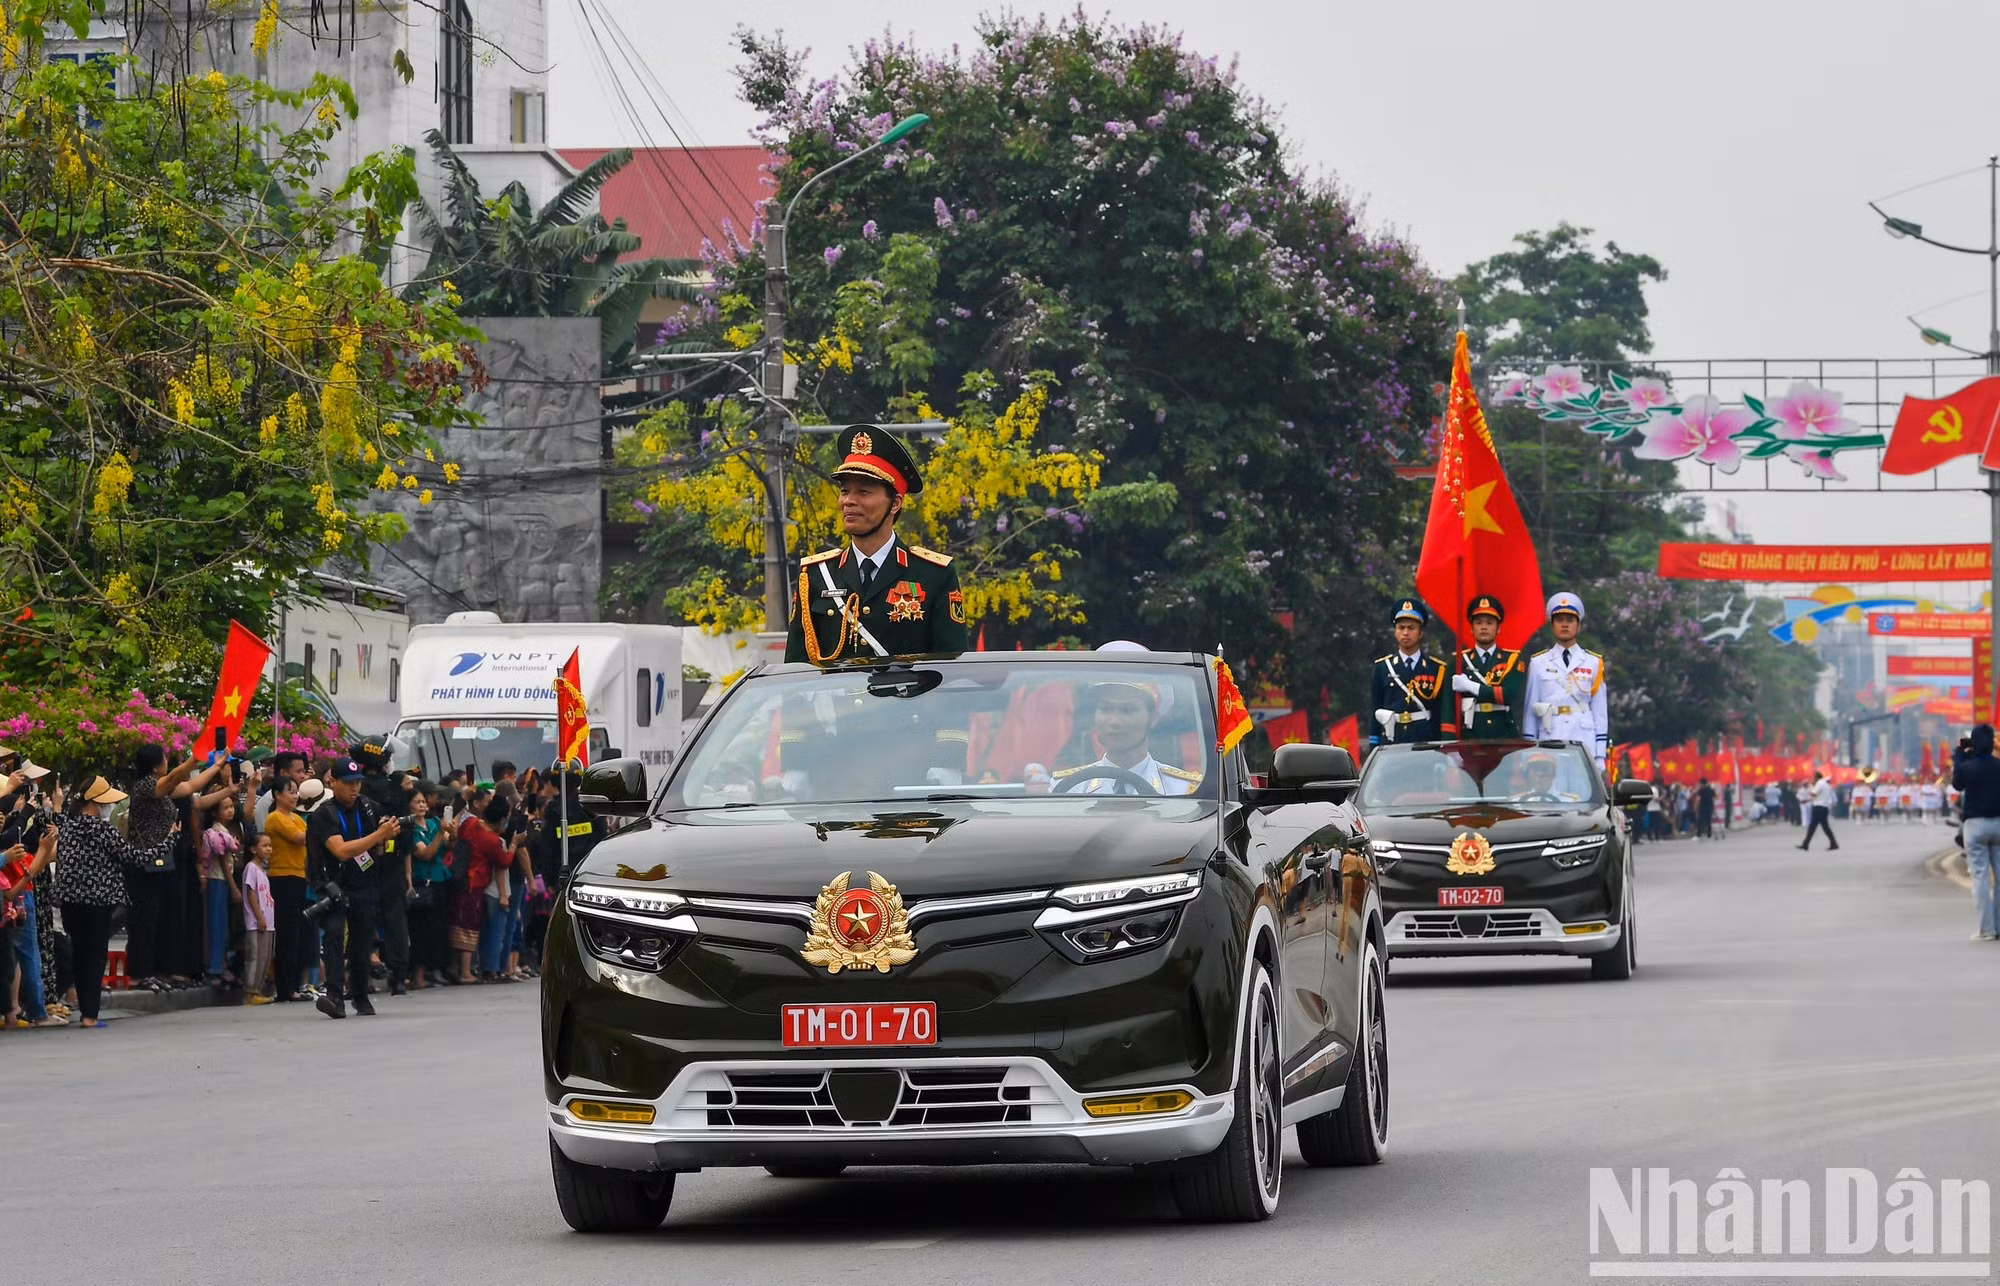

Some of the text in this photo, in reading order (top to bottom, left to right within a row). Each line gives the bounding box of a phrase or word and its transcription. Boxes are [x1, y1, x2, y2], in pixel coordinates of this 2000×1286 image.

[491, 653, 558, 661] VNPT
[431, 685, 557, 701] PHÁT HÌNH LƯU ĐỘNG
[459, 719, 518, 728] MITSUBISHI
[1441, 889, 1501, 904] TM-02-70
[787, 1008, 931, 1042] TM-01-70
